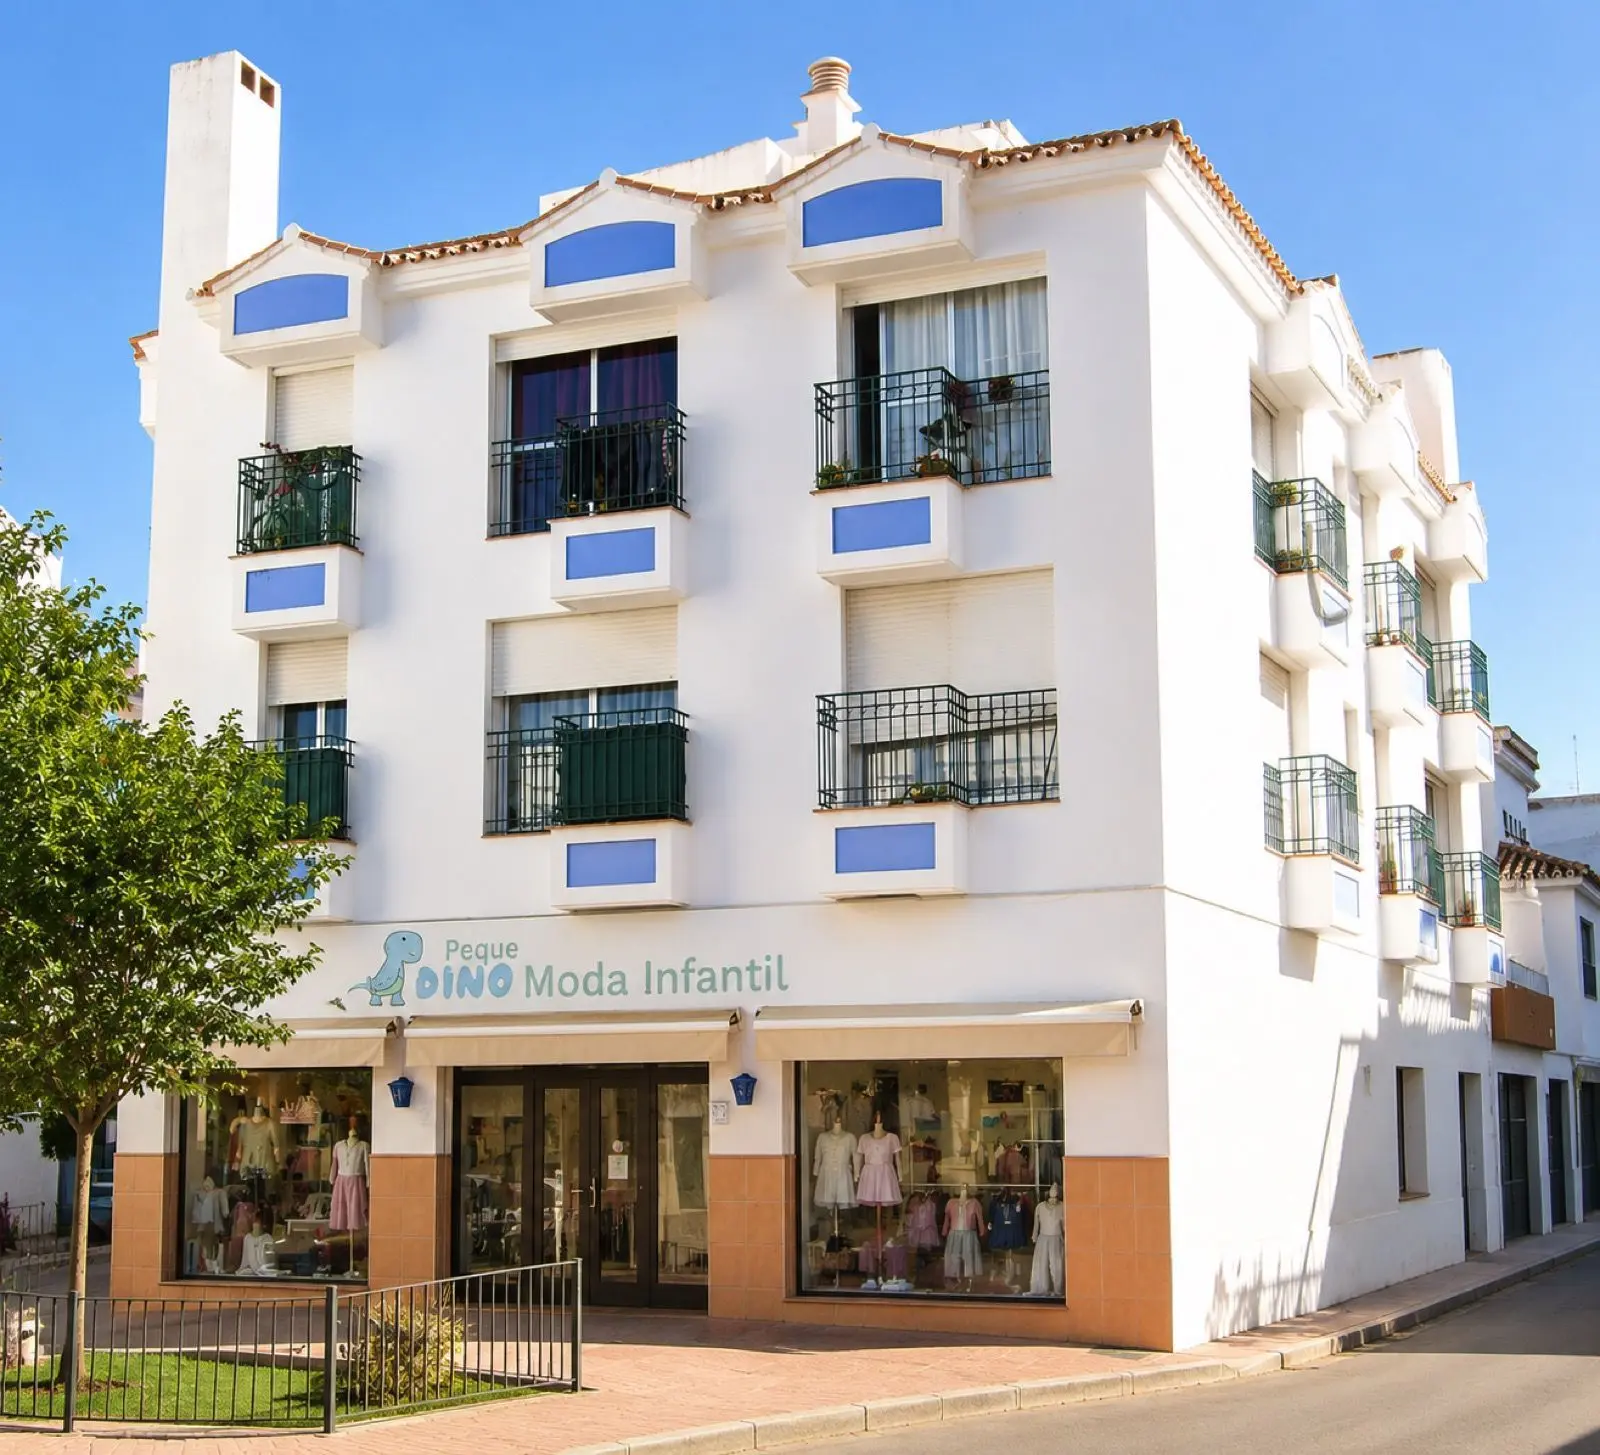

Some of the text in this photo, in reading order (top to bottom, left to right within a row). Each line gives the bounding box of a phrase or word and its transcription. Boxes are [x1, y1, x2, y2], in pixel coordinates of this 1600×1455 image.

[445, 939, 519, 966] Peque
[524, 961, 629, 998] Moda
[644, 954, 789, 995] Infantil
